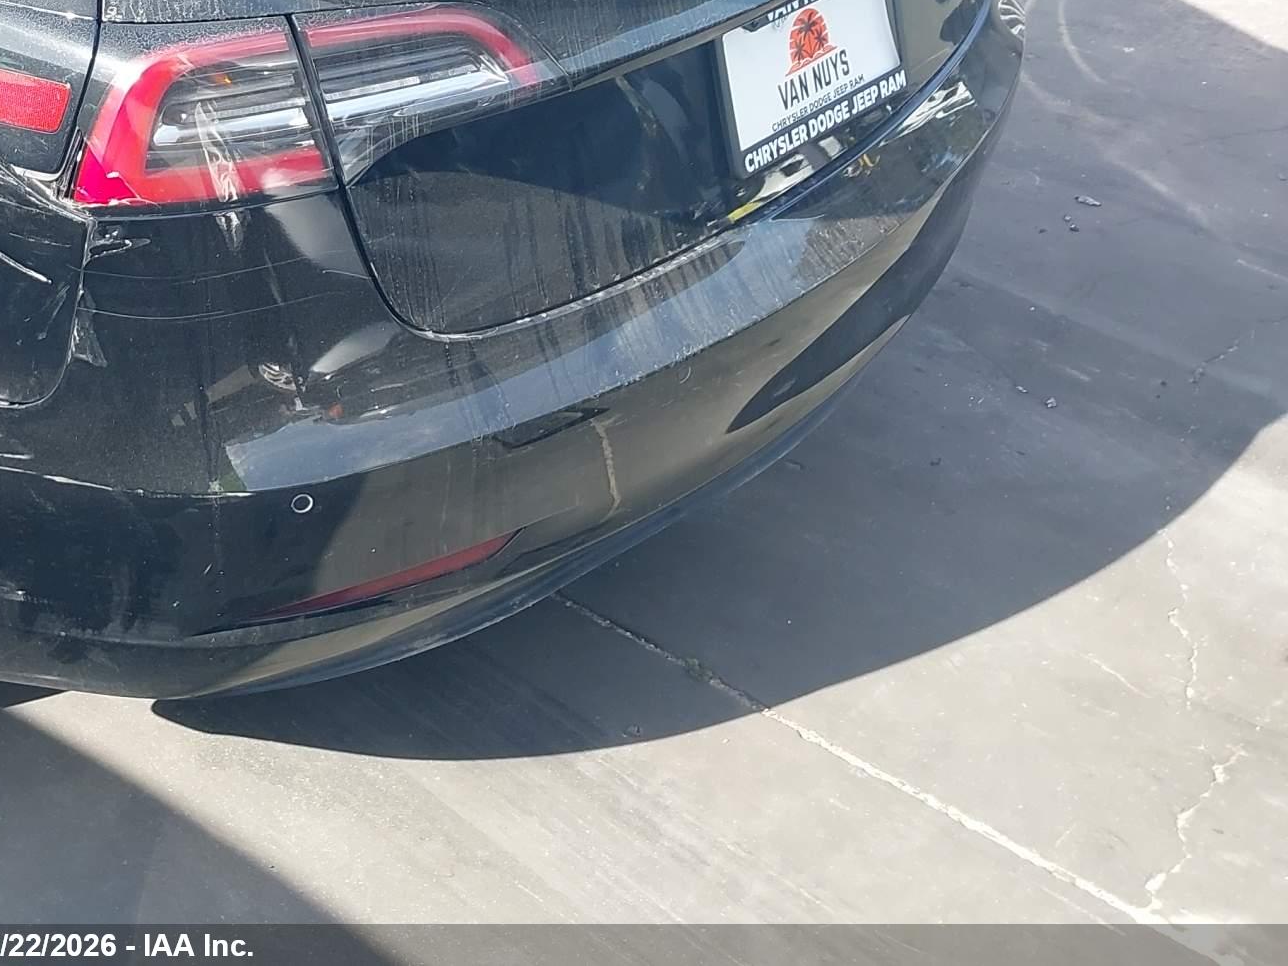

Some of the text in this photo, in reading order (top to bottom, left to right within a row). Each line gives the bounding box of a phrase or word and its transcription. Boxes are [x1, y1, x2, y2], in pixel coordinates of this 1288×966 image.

[771, 74, 865, 132] CHRYSLER DODGE JEEP RAM
[777, 48, 850, 111] VAN NUYS
[744, 69, 907, 173] CHRYSLER DODGE JEEP RAM
